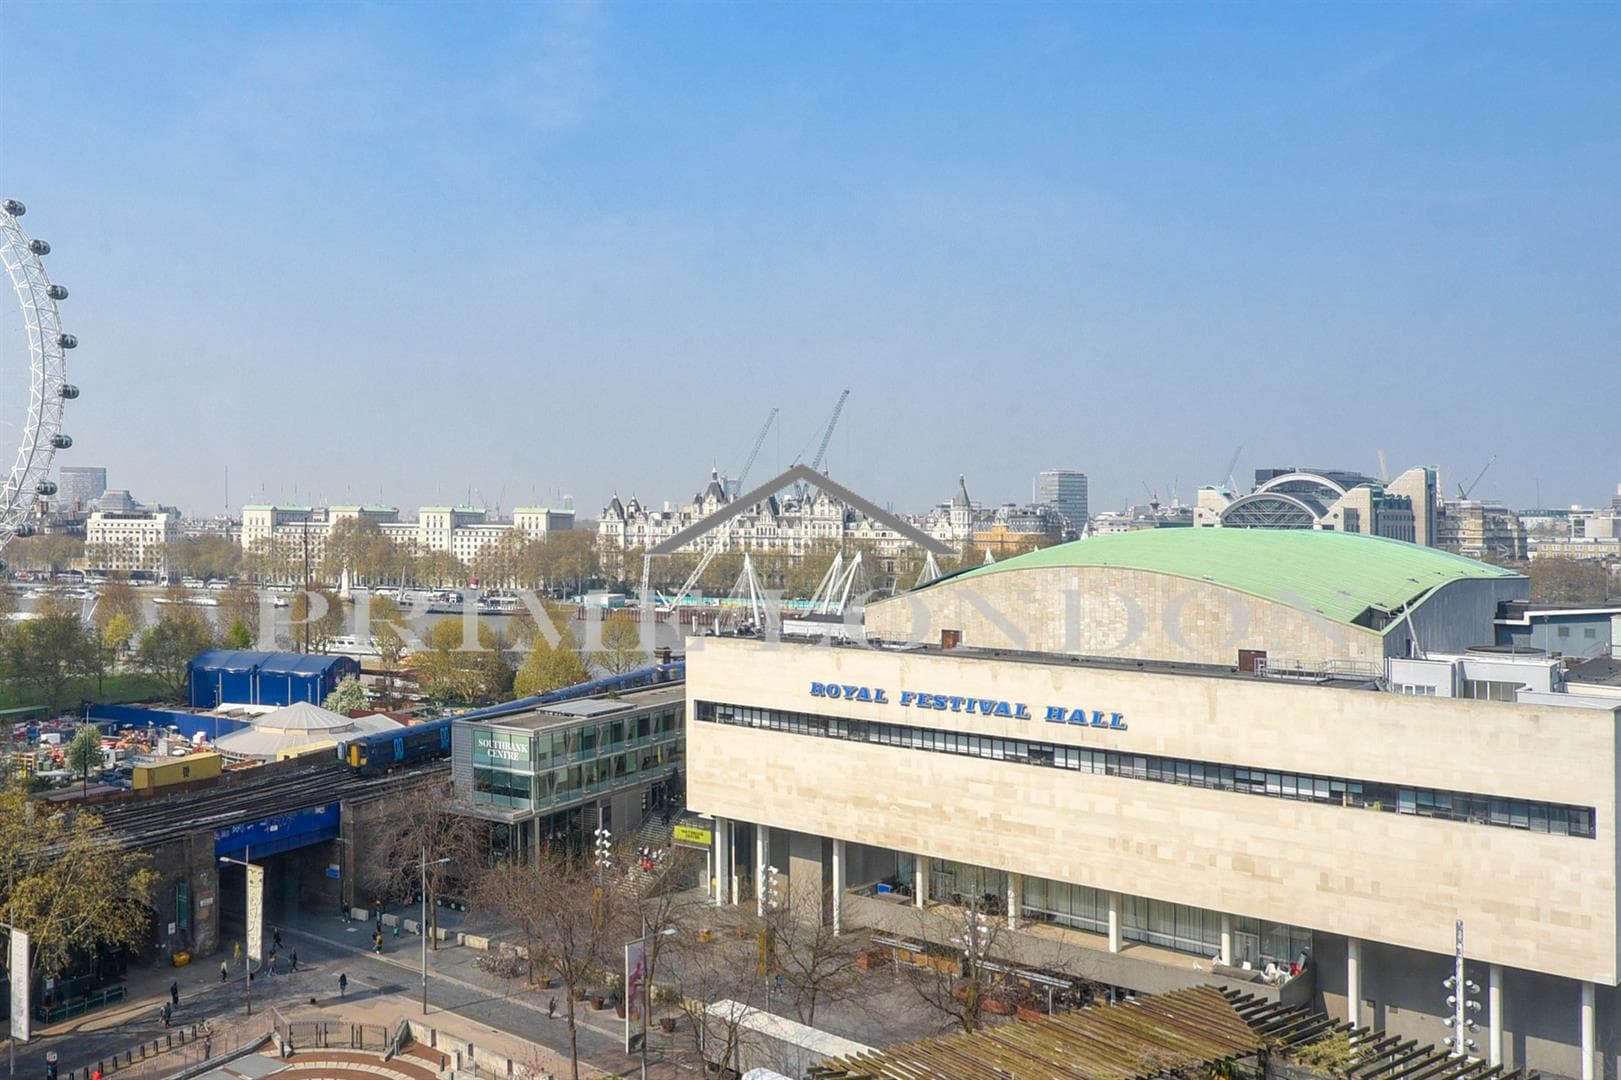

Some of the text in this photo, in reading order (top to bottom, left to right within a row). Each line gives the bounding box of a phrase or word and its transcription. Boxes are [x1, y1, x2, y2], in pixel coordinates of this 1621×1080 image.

[810, 682, 1127, 730] ROYAL FESTIVAL HALL
[478, 738, 528, 753] SOUTHBANK
[487, 748, 519, 761] CENTRE
